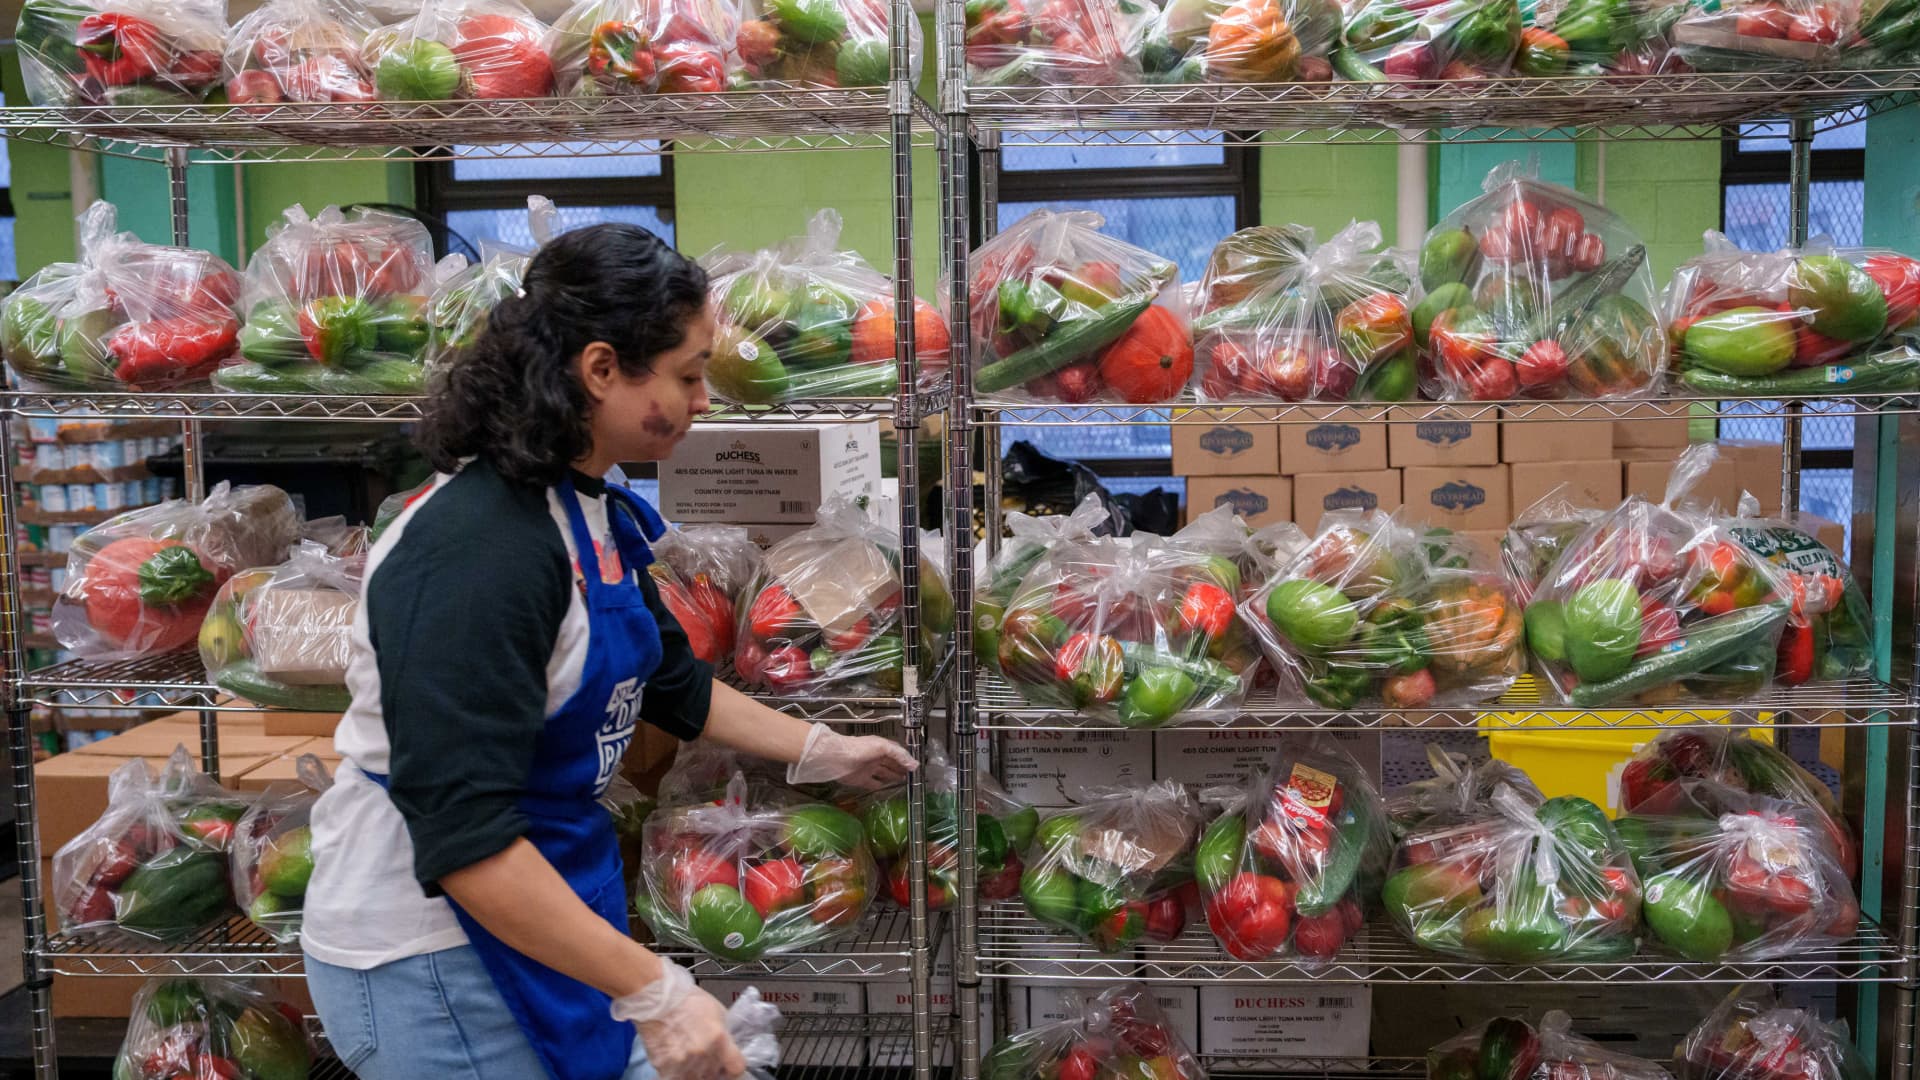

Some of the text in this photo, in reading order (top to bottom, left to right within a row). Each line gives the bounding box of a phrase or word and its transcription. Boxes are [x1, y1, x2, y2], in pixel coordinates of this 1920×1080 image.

[1417, 422, 1471, 436] RIVERHEAD
[1201, 437, 1252, 447] RIVERHEAD
[1308, 431, 1360, 443] RIVERHEAD
[716, 450, 761, 462] DUCHESS
[774, 468, 798, 476] WATER
[1325, 495, 1377, 507] RIVERHEAD
[1432, 491, 1484, 503] RIVERHEAD
[1234, 998, 1306, 1009] DUCHESS
